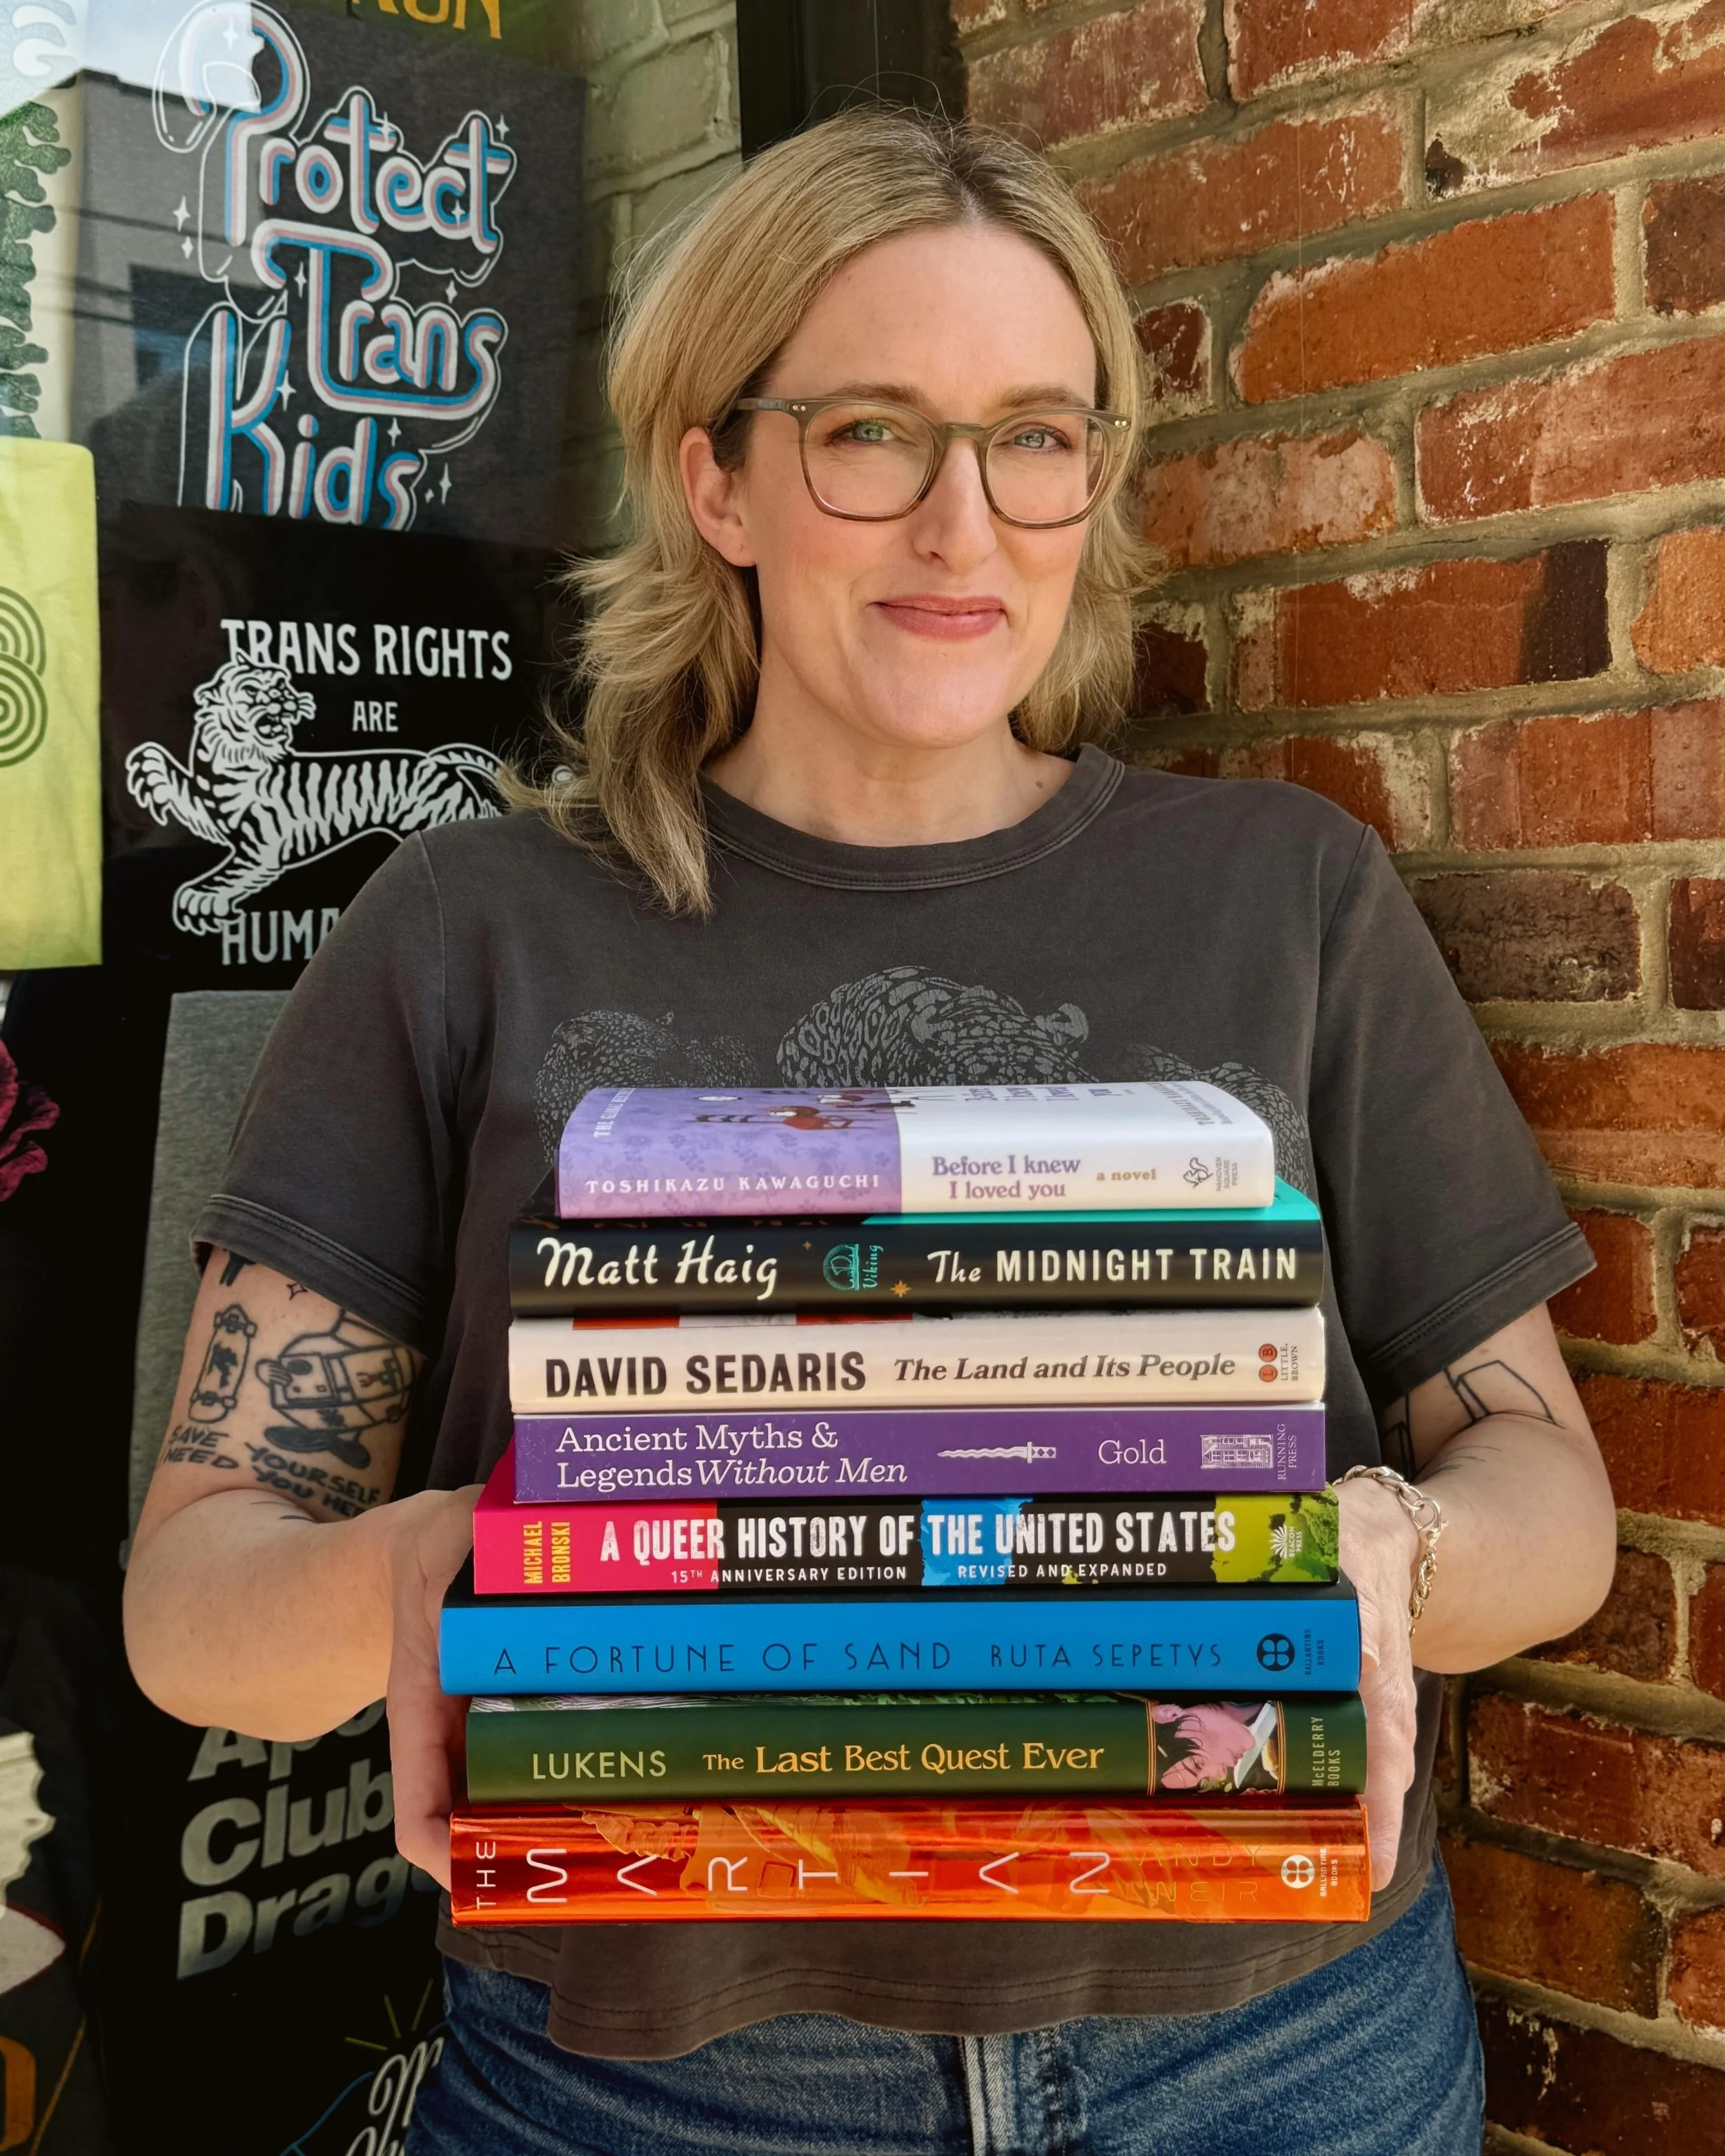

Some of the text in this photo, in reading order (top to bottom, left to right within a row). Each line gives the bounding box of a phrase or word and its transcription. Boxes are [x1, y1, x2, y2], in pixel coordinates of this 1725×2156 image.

[177, 7, 513, 254] Protect
[251, 219, 502, 419] Trans
[206, 310, 420, 531] Kids
[221, 618, 513, 681] TRANS RIGHTS
[352, 701, 399, 733] ARE
[585, 1174, 880, 1194] TOSHIKAZU KAWAGUCHI
[932, 1155, 1081, 1176] Before I knew
[1096, 1168, 1156, 1181] a novel
[949, 1180, 1065, 1200] I loved you
[537, 1234, 778, 1301] Matt Haig
[862, 1245, 883, 1289] Viking
[927, 1247, 1297, 1283] The MIDNIGHT TRAIN
[545, 1351, 865, 1398] DAVID SEDARIS
[894, 1353, 1235, 1382] The Land and Its People
[555, 1421, 838, 1456] Ancient Myths &
[1098, 1438, 1167, 1465] Gold
[1276, 1423, 1287, 1481] RUNNING
[1288, 1434, 1297, 1468] PRESS
[164, 1447, 239, 1469] NEED
[252, 1465, 313, 1499] YOU
[169, 1425, 380, 1505] SAVE YOURSELF
[557, 1457, 907, 1492] Legends Without Men
[523, 1521, 544, 1584] MICHAEL
[551, 1521, 571, 1583] BRONSKI
[600, 1510, 1236, 1566] A QUEER HISTORY OF THE UNITED STATES
[671, 1565, 907, 1584] 15TH ANNIVERSARY EDITION
[958, 1562, 1167, 1579] REVISED AND EXPANDED
[493, 1641, 1223, 1676] A FORTUNE OF SAND RUTA SEPETYS
[533, 1742, 1104, 1781] LUKENS The Last Best Quest Ever
[1311, 1717, 1325, 1787] McELDERRY
[1327, 1749, 1341, 1786] BOOKS
[180, 1757, 395, 1888] Club
[1138, 1842, 1265, 1867] ANDY
[476, 1841, 496, 1910] THE
[1144, 1881, 1259, 1902] WEIR
